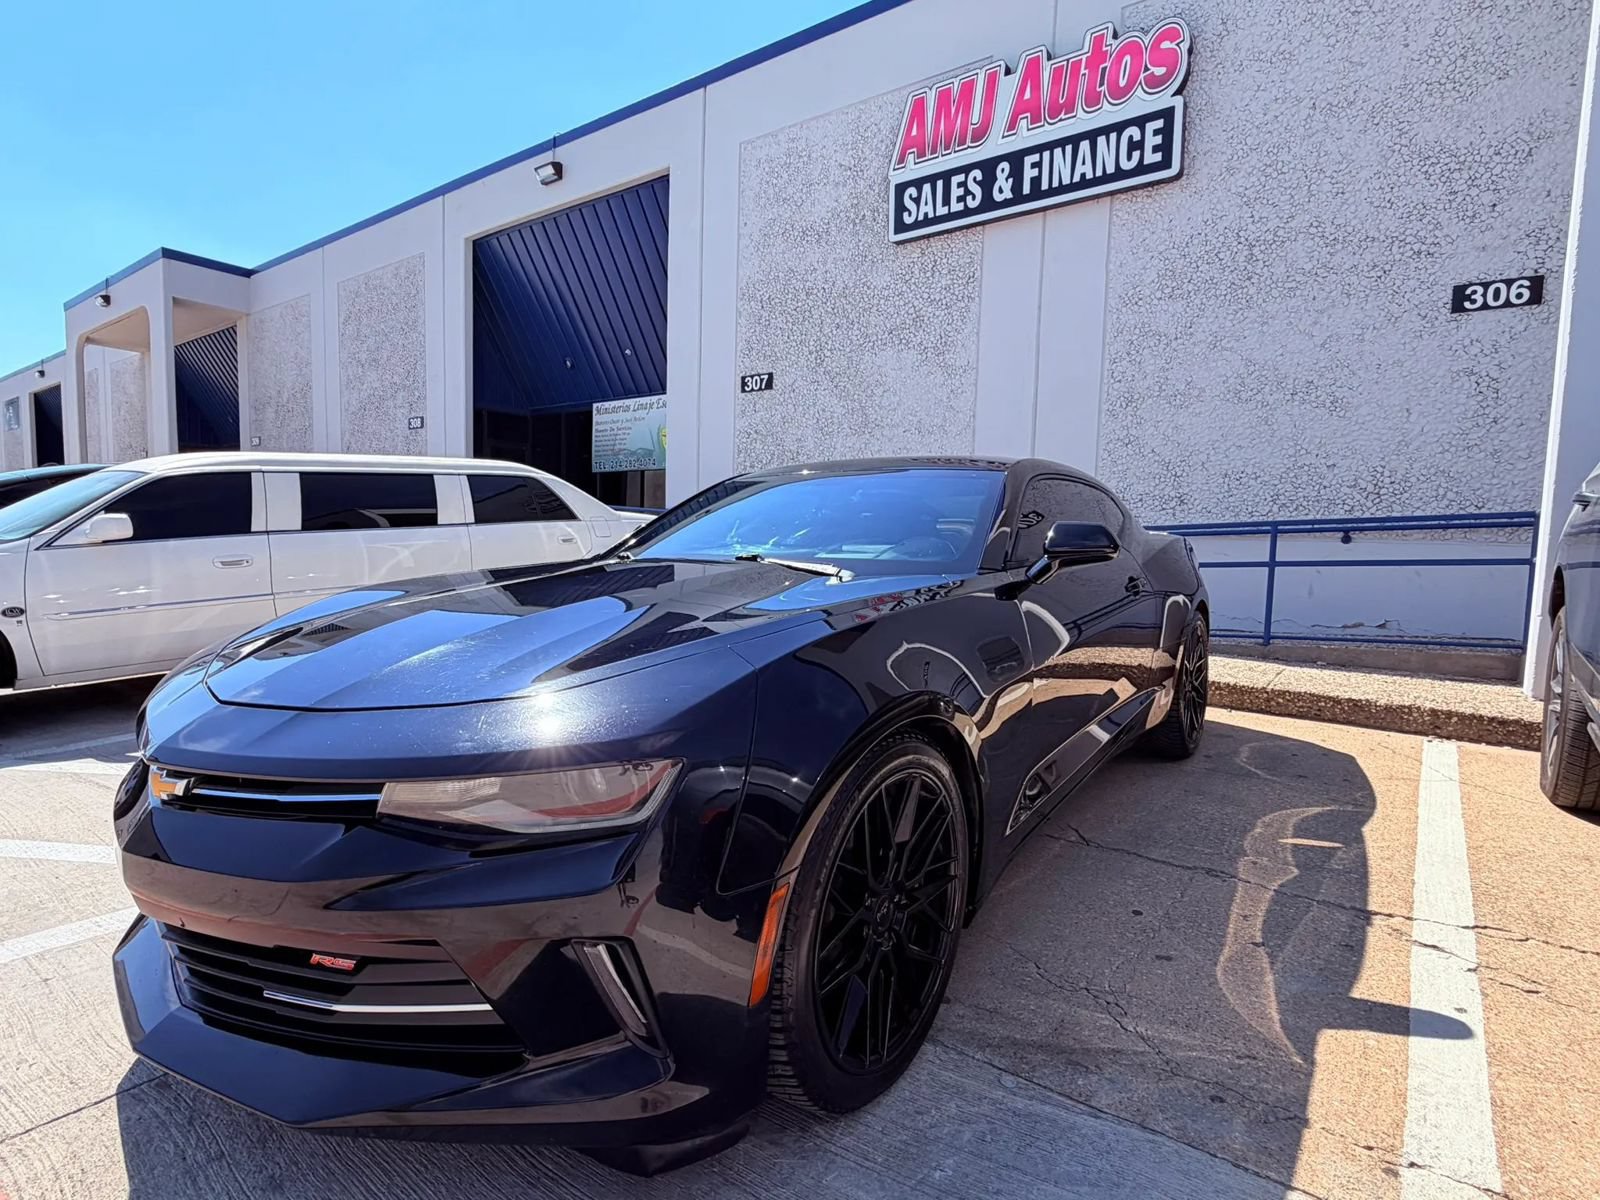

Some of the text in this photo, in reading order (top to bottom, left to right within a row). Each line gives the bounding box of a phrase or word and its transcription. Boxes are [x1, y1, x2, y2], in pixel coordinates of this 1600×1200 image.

[894, 21, 1185, 168] AMJ Autos
[903, 118, 1166, 225] SALES & FINANCE
[1463, 279, 1532, 310] 306
[744, 375, 769, 392] 307
[594, 402, 631, 416] Ministerios
[632, 399, 656, 415] Linaje
[409, 418, 422, 429] 308
[309, 953, 357, 971] RS
